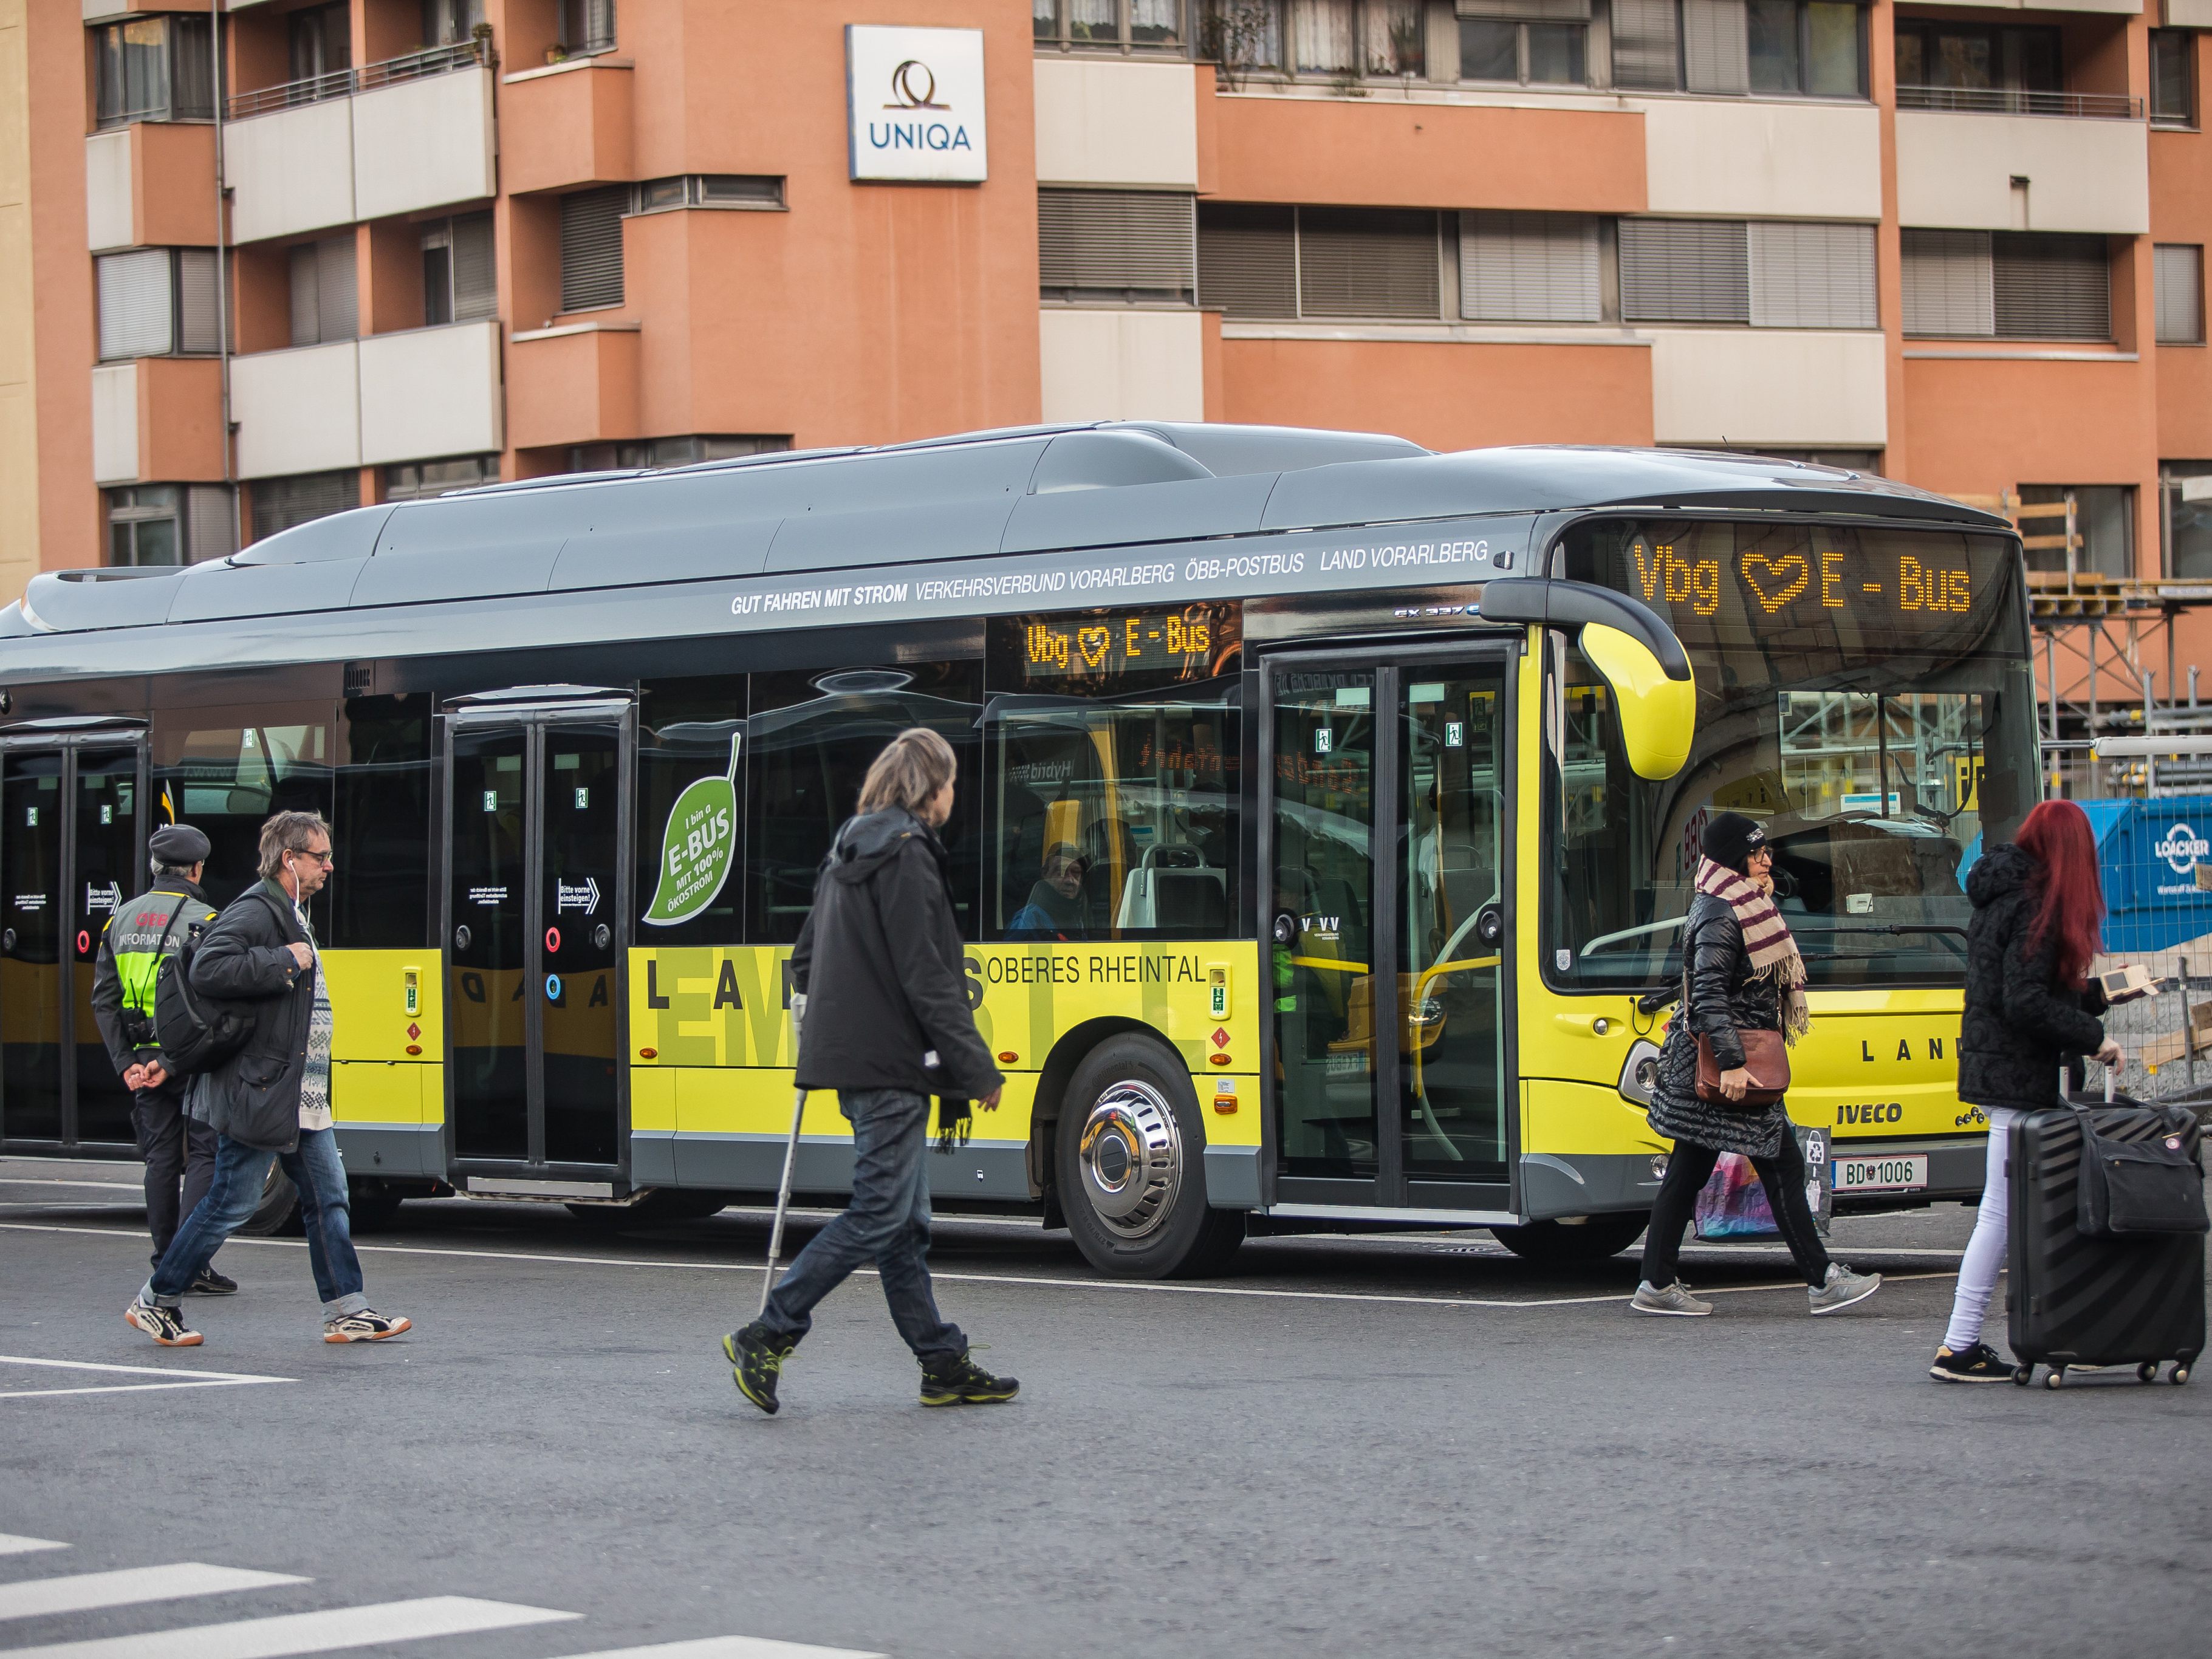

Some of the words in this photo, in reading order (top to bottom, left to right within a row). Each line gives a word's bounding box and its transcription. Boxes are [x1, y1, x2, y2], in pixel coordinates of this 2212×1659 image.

[870, 123, 971, 151] UNIQA
[1185, 552, 1305, 582] ÖBB-POSTBUS
[1320, 548, 1366, 572] LAND
[1371, 540, 1488, 568] VORARLBERG
[916, 572, 1066, 601] VERKEHRSVERBUND
[1069, 563, 1175, 590] VORARLBERG
[1634, 544, 1718, 615] Vbg
[1822, 552, 1843, 607] E
[1900, 556, 1970, 612] Bus
[731, 594, 762, 615] GUT
[763, 590, 822, 611] FAHREN
[824, 587, 852, 607] MIT
[854, 583, 908, 604] STROM
[1425, 607, 1465, 616] 337
[1027, 625, 1069, 668] Vbg
[1126, 618, 1142, 656] E
[1166, 615, 1210, 654] Bus
[685, 818, 690, 830] I
[690, 809, 704, 826] bin
[705, 804, 711, 815] a
[668, 807, 730, 877] E-BUS
[2155, 839, 2210, 858] LOACKER
[676, 871, 692, 892] MIT
[693, 846, 724, 876] 100%
[561, 894, 591, 904] einsteigen!
[668, 871, 713, 912] ÖKOSTROM
[119, 933, 180, 947] INFORMATON
[987, 956, 1080, 983] OBERES
[1089, 955, 1207, 983] RHEINTAL
[1837, 1103, 1902, 1124] IVECO
[1846, 1163, 1865, 1185] BD
[1877, 1160, 1913, 1183] 1006
